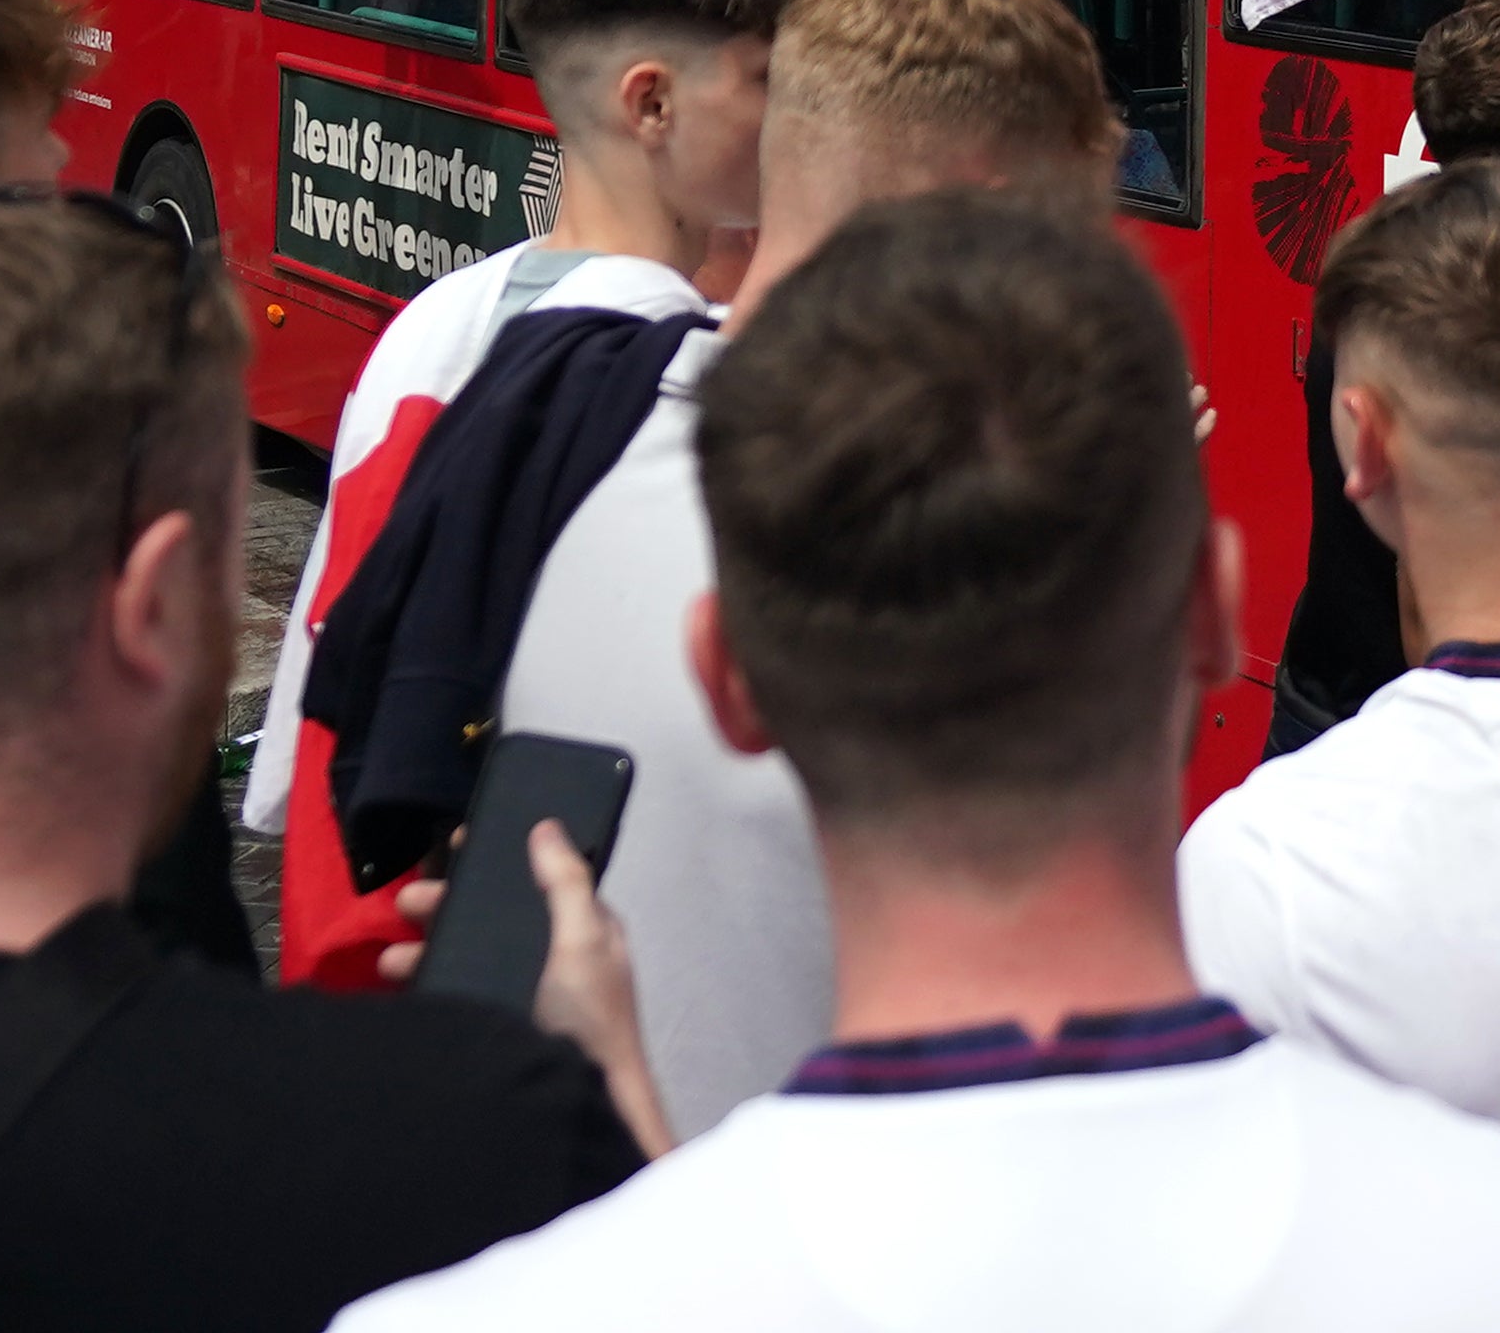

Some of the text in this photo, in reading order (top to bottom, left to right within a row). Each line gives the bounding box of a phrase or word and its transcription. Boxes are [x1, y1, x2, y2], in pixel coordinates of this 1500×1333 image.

[292, 98, 498, 218] Rent Smarter
[290, 171, 350, 249] Live
